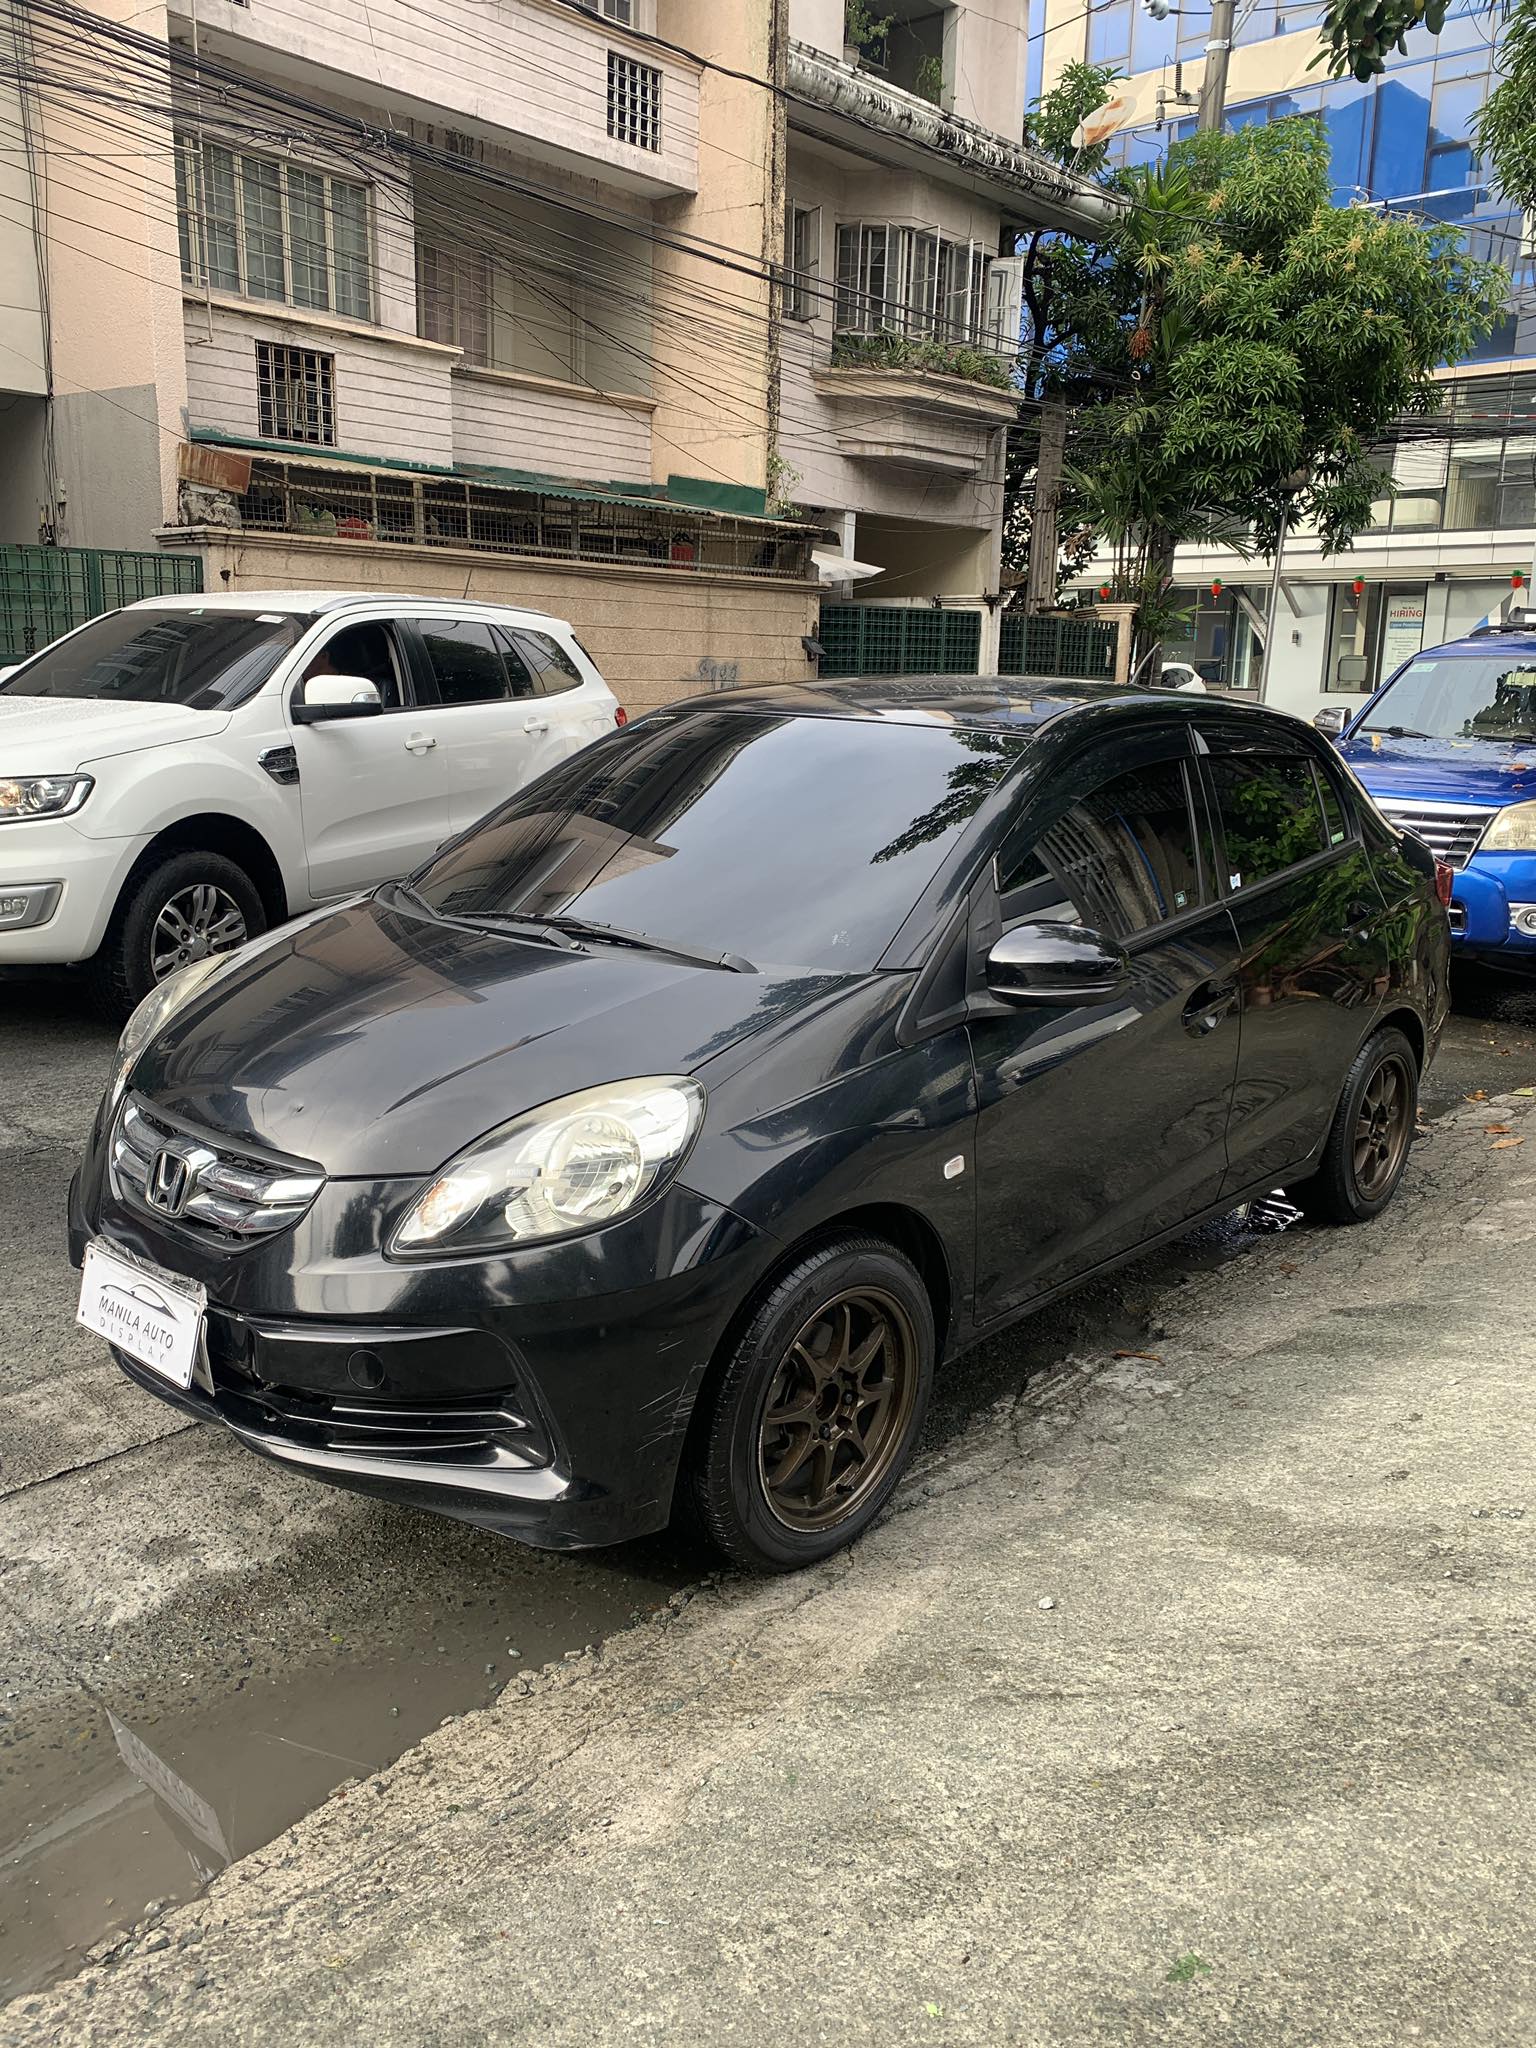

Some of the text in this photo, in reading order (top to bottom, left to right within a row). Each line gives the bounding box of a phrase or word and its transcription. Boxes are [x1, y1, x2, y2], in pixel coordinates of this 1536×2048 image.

[1390, 609, 1422, 618] HIRING
[98, 1295, 174, 1349] MANILA AUTO
[99, 1316, 165, 1362] DISPLAY
